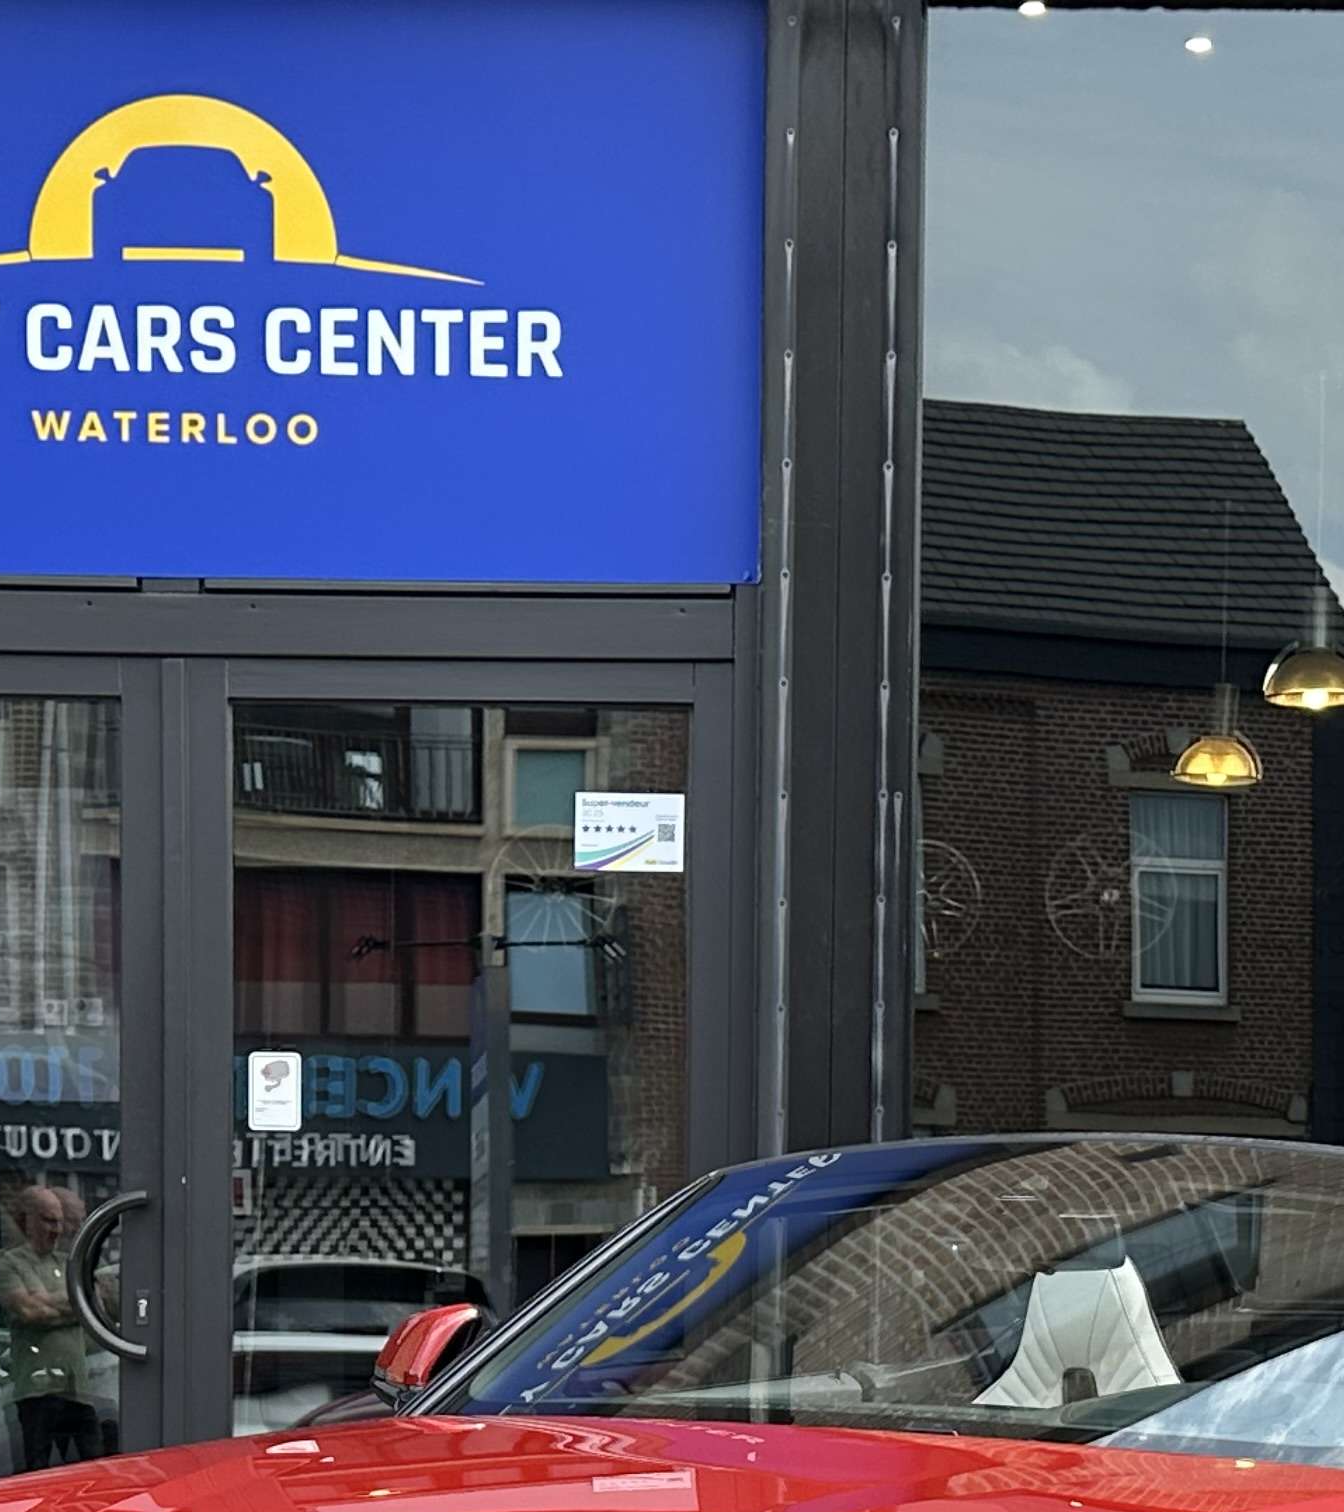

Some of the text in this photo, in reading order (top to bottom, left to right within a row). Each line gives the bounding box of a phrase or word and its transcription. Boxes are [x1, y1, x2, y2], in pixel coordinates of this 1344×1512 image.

[26, 303, 237, 374] CARS
[265, 307, 564, 378] CENTER
[31, 409, 319, 446] WATERLOO
